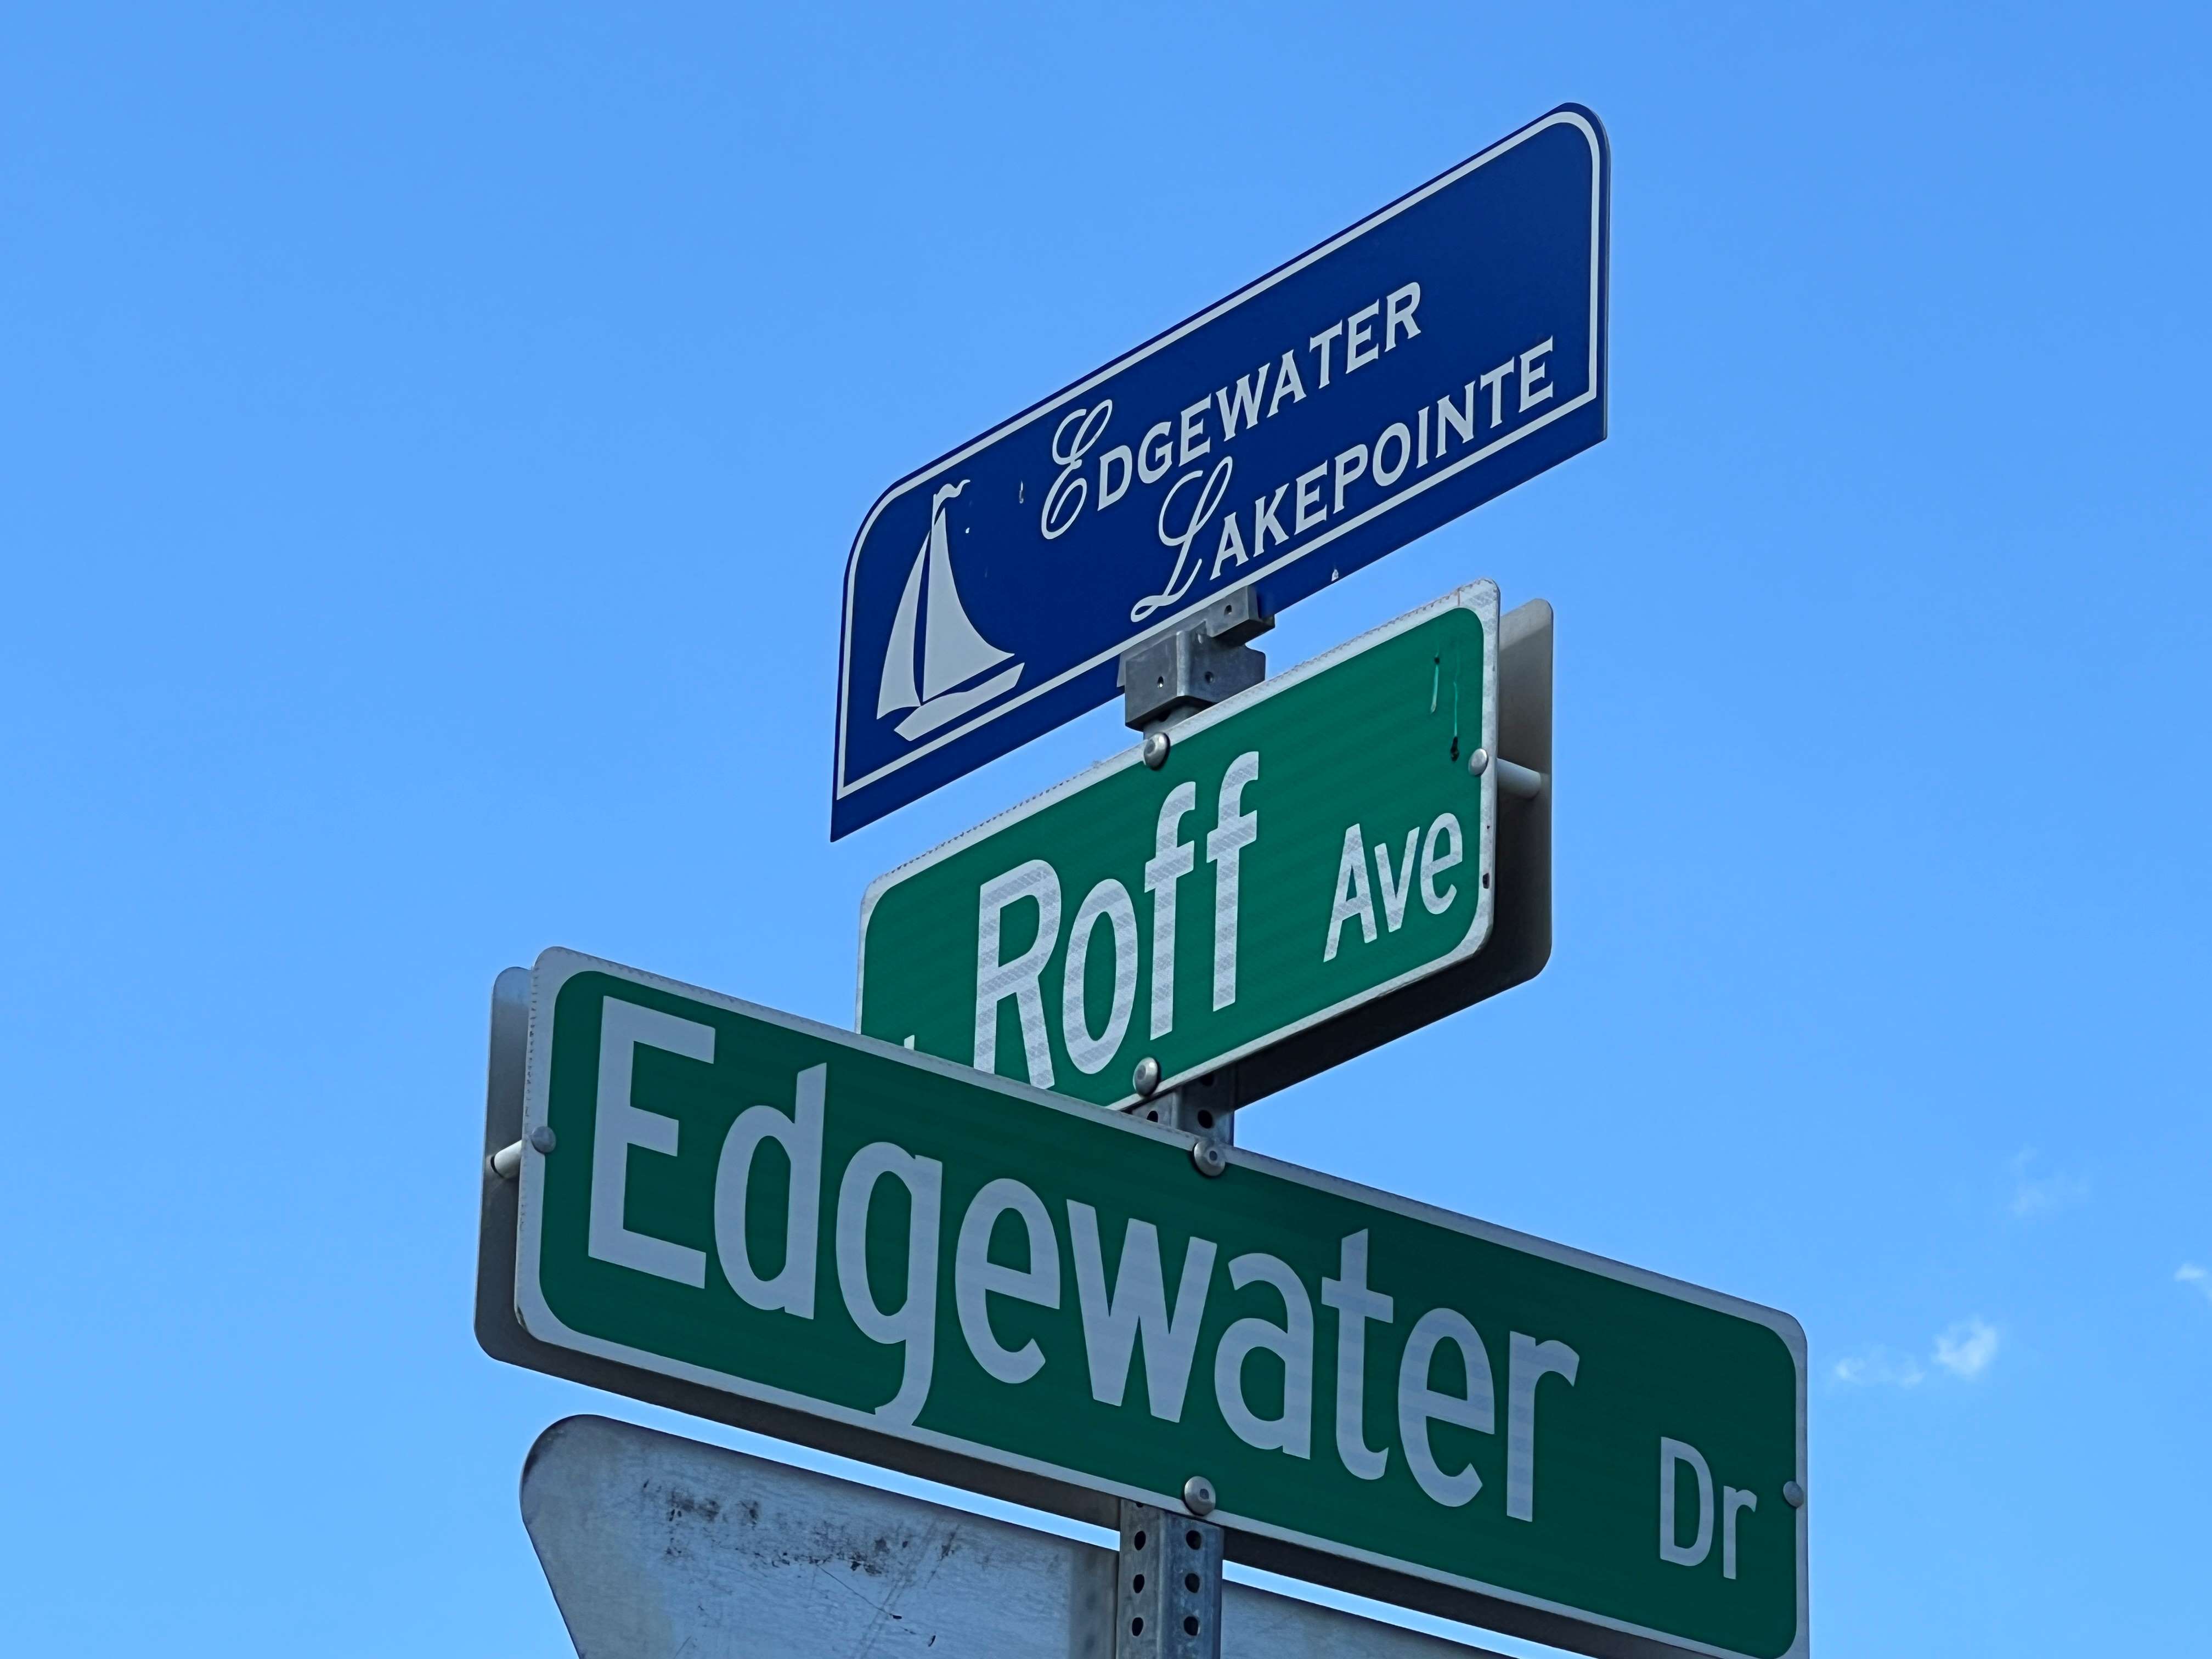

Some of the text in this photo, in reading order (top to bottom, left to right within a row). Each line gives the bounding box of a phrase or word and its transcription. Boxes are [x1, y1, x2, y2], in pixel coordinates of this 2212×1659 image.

[1041, 281, 1423, 540] EDGEWATER
[1130, 337, 1555, 623] LAKEPOINTE
[973, 752, 1463, 1089] Roff Ave
[587, 996, 1757, 1580] Edgewater Dr
